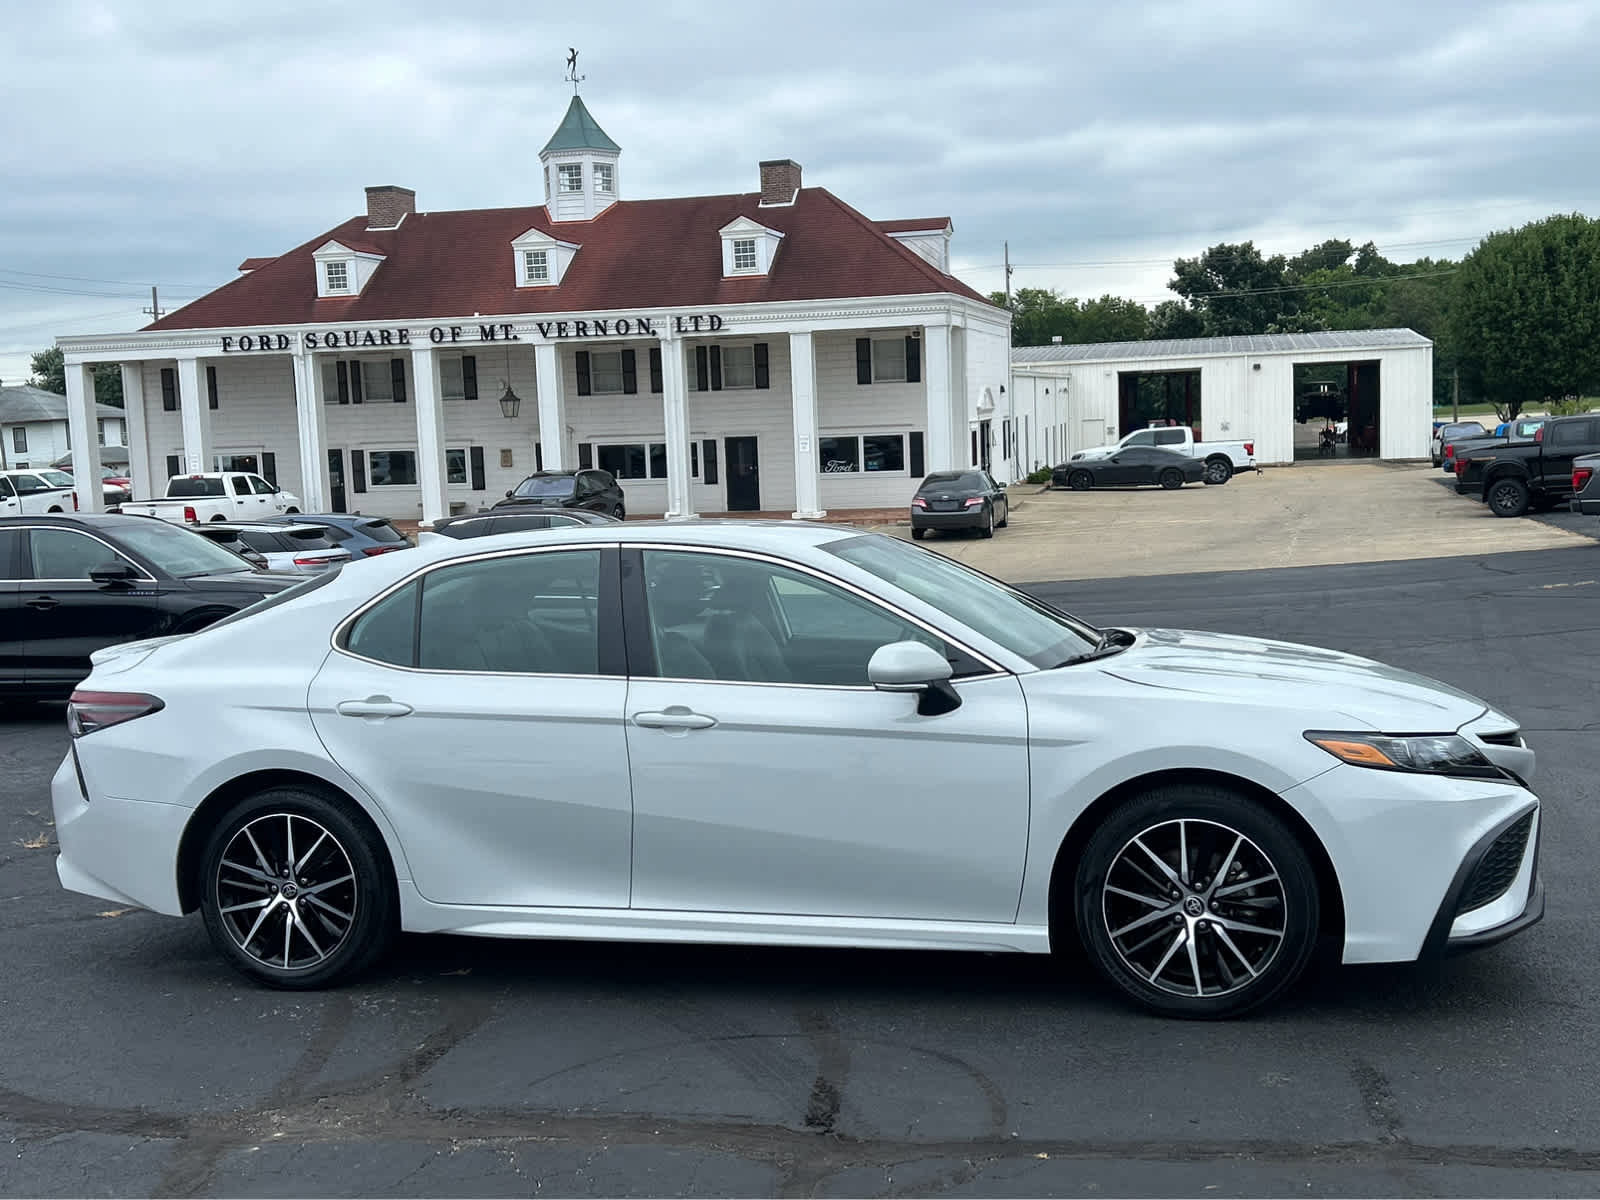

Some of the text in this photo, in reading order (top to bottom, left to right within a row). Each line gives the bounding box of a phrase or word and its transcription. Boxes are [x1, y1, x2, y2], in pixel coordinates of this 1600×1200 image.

[221, 334, 290, 352] FORD
[305, 329, 411, 349] SQUARE
[430, 326, 463, 343] OF
[479, 323, 518, 341] MT.
[675, 315, 723, 333] LTD
[824, 459, 854, 472] Ford
